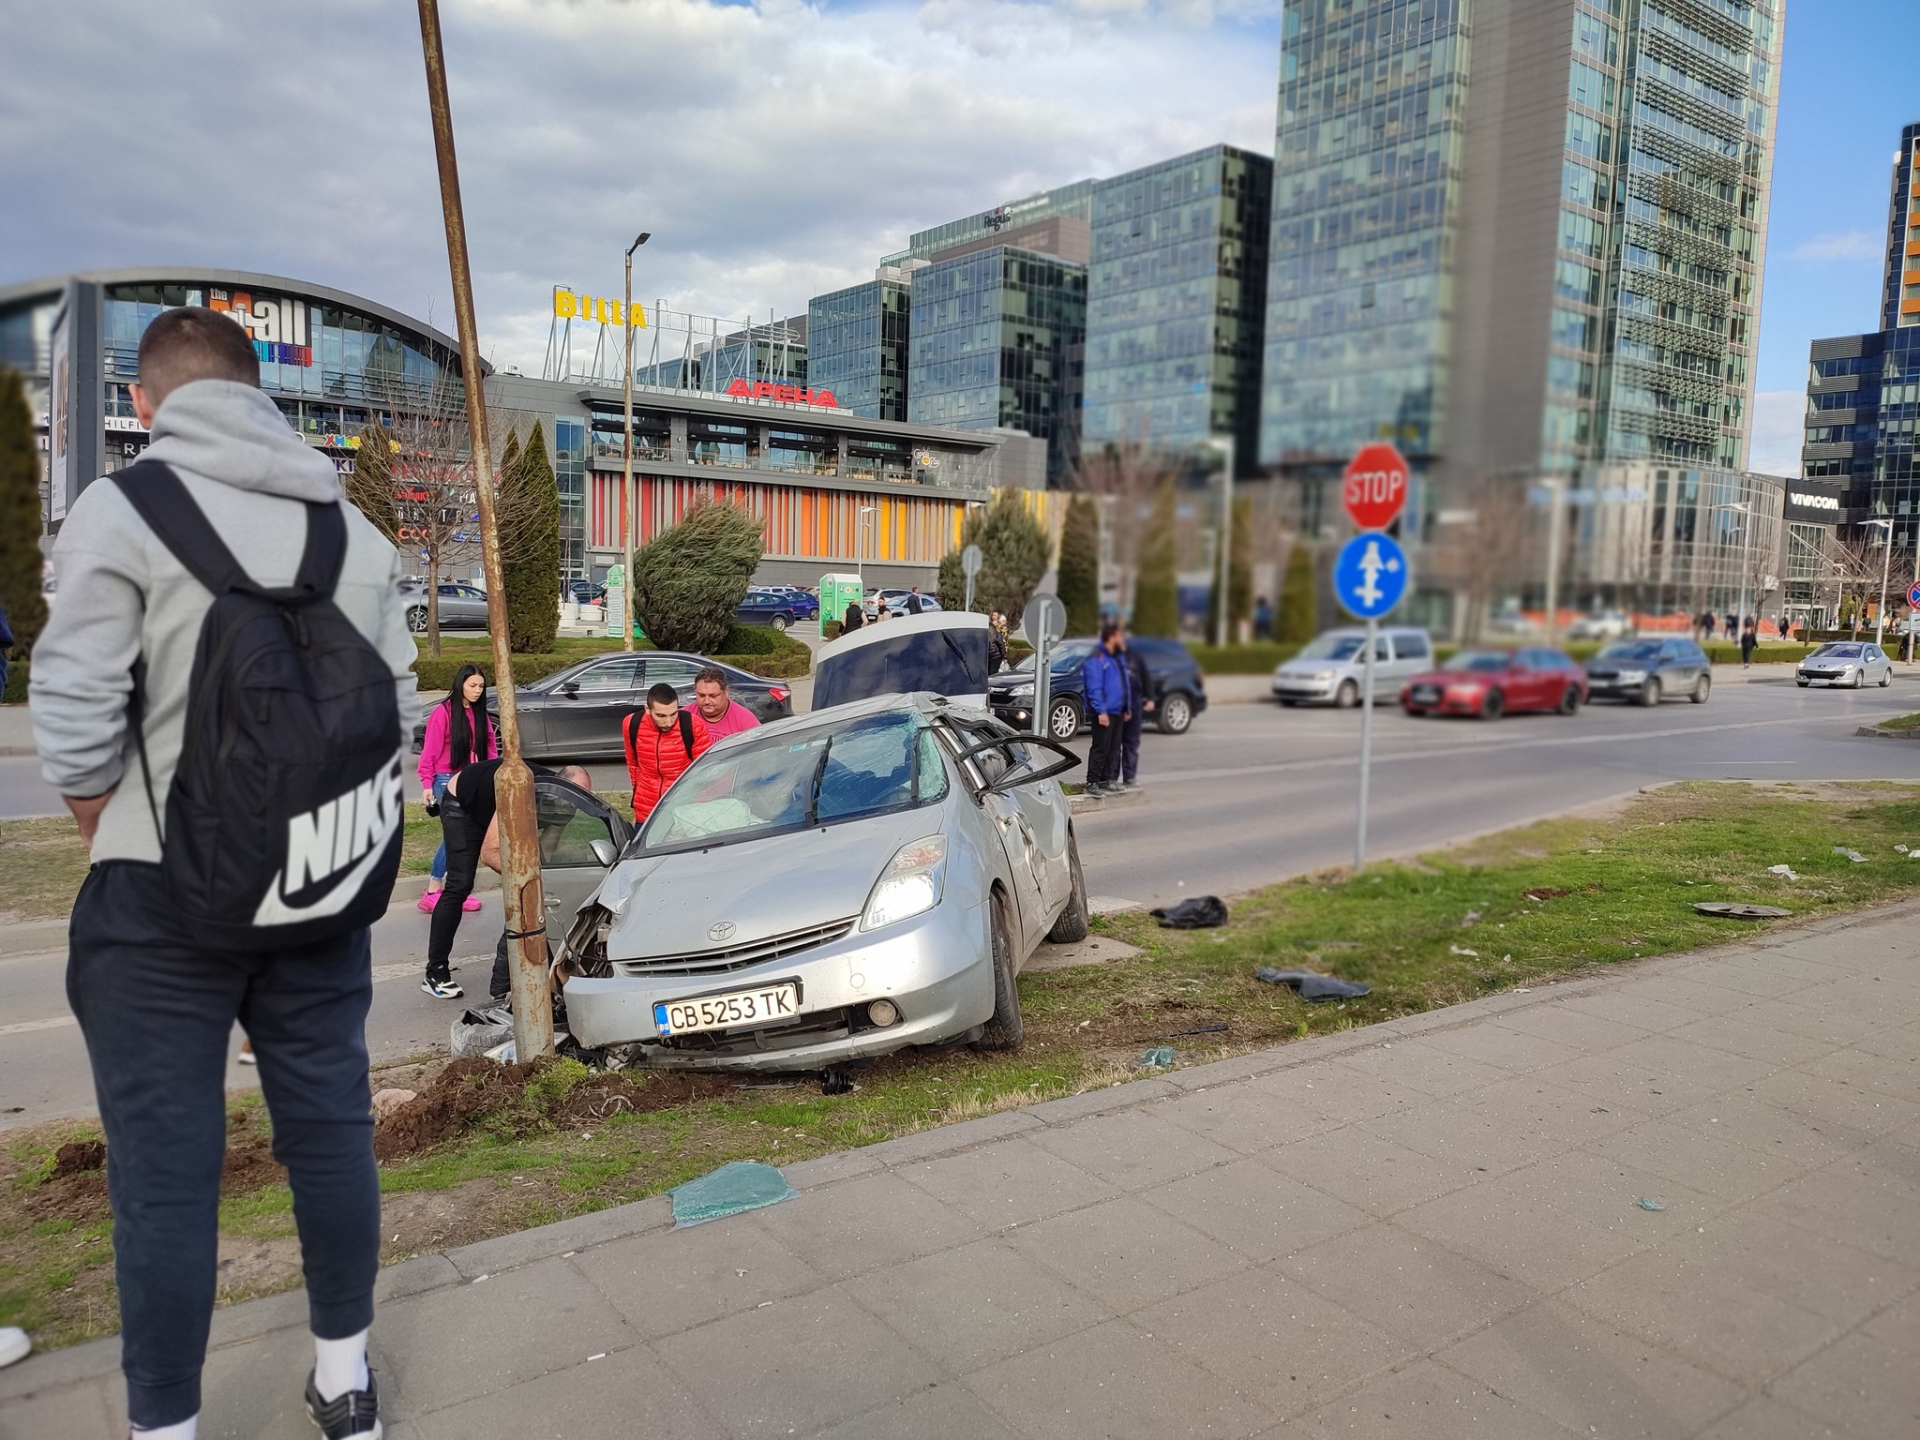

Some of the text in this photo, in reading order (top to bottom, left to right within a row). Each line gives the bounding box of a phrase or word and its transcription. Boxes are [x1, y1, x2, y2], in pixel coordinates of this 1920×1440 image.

[210, 287, 228, 301] the
[555, 290, 647, 329] BILLA
[105, 418, 140, 430] HILFI
[1350, 470, 1402, 504] STOP
[1790, 492, 1839, 511] VIVACOM
[671, 989, 792, 1029] CB 5253 TK
